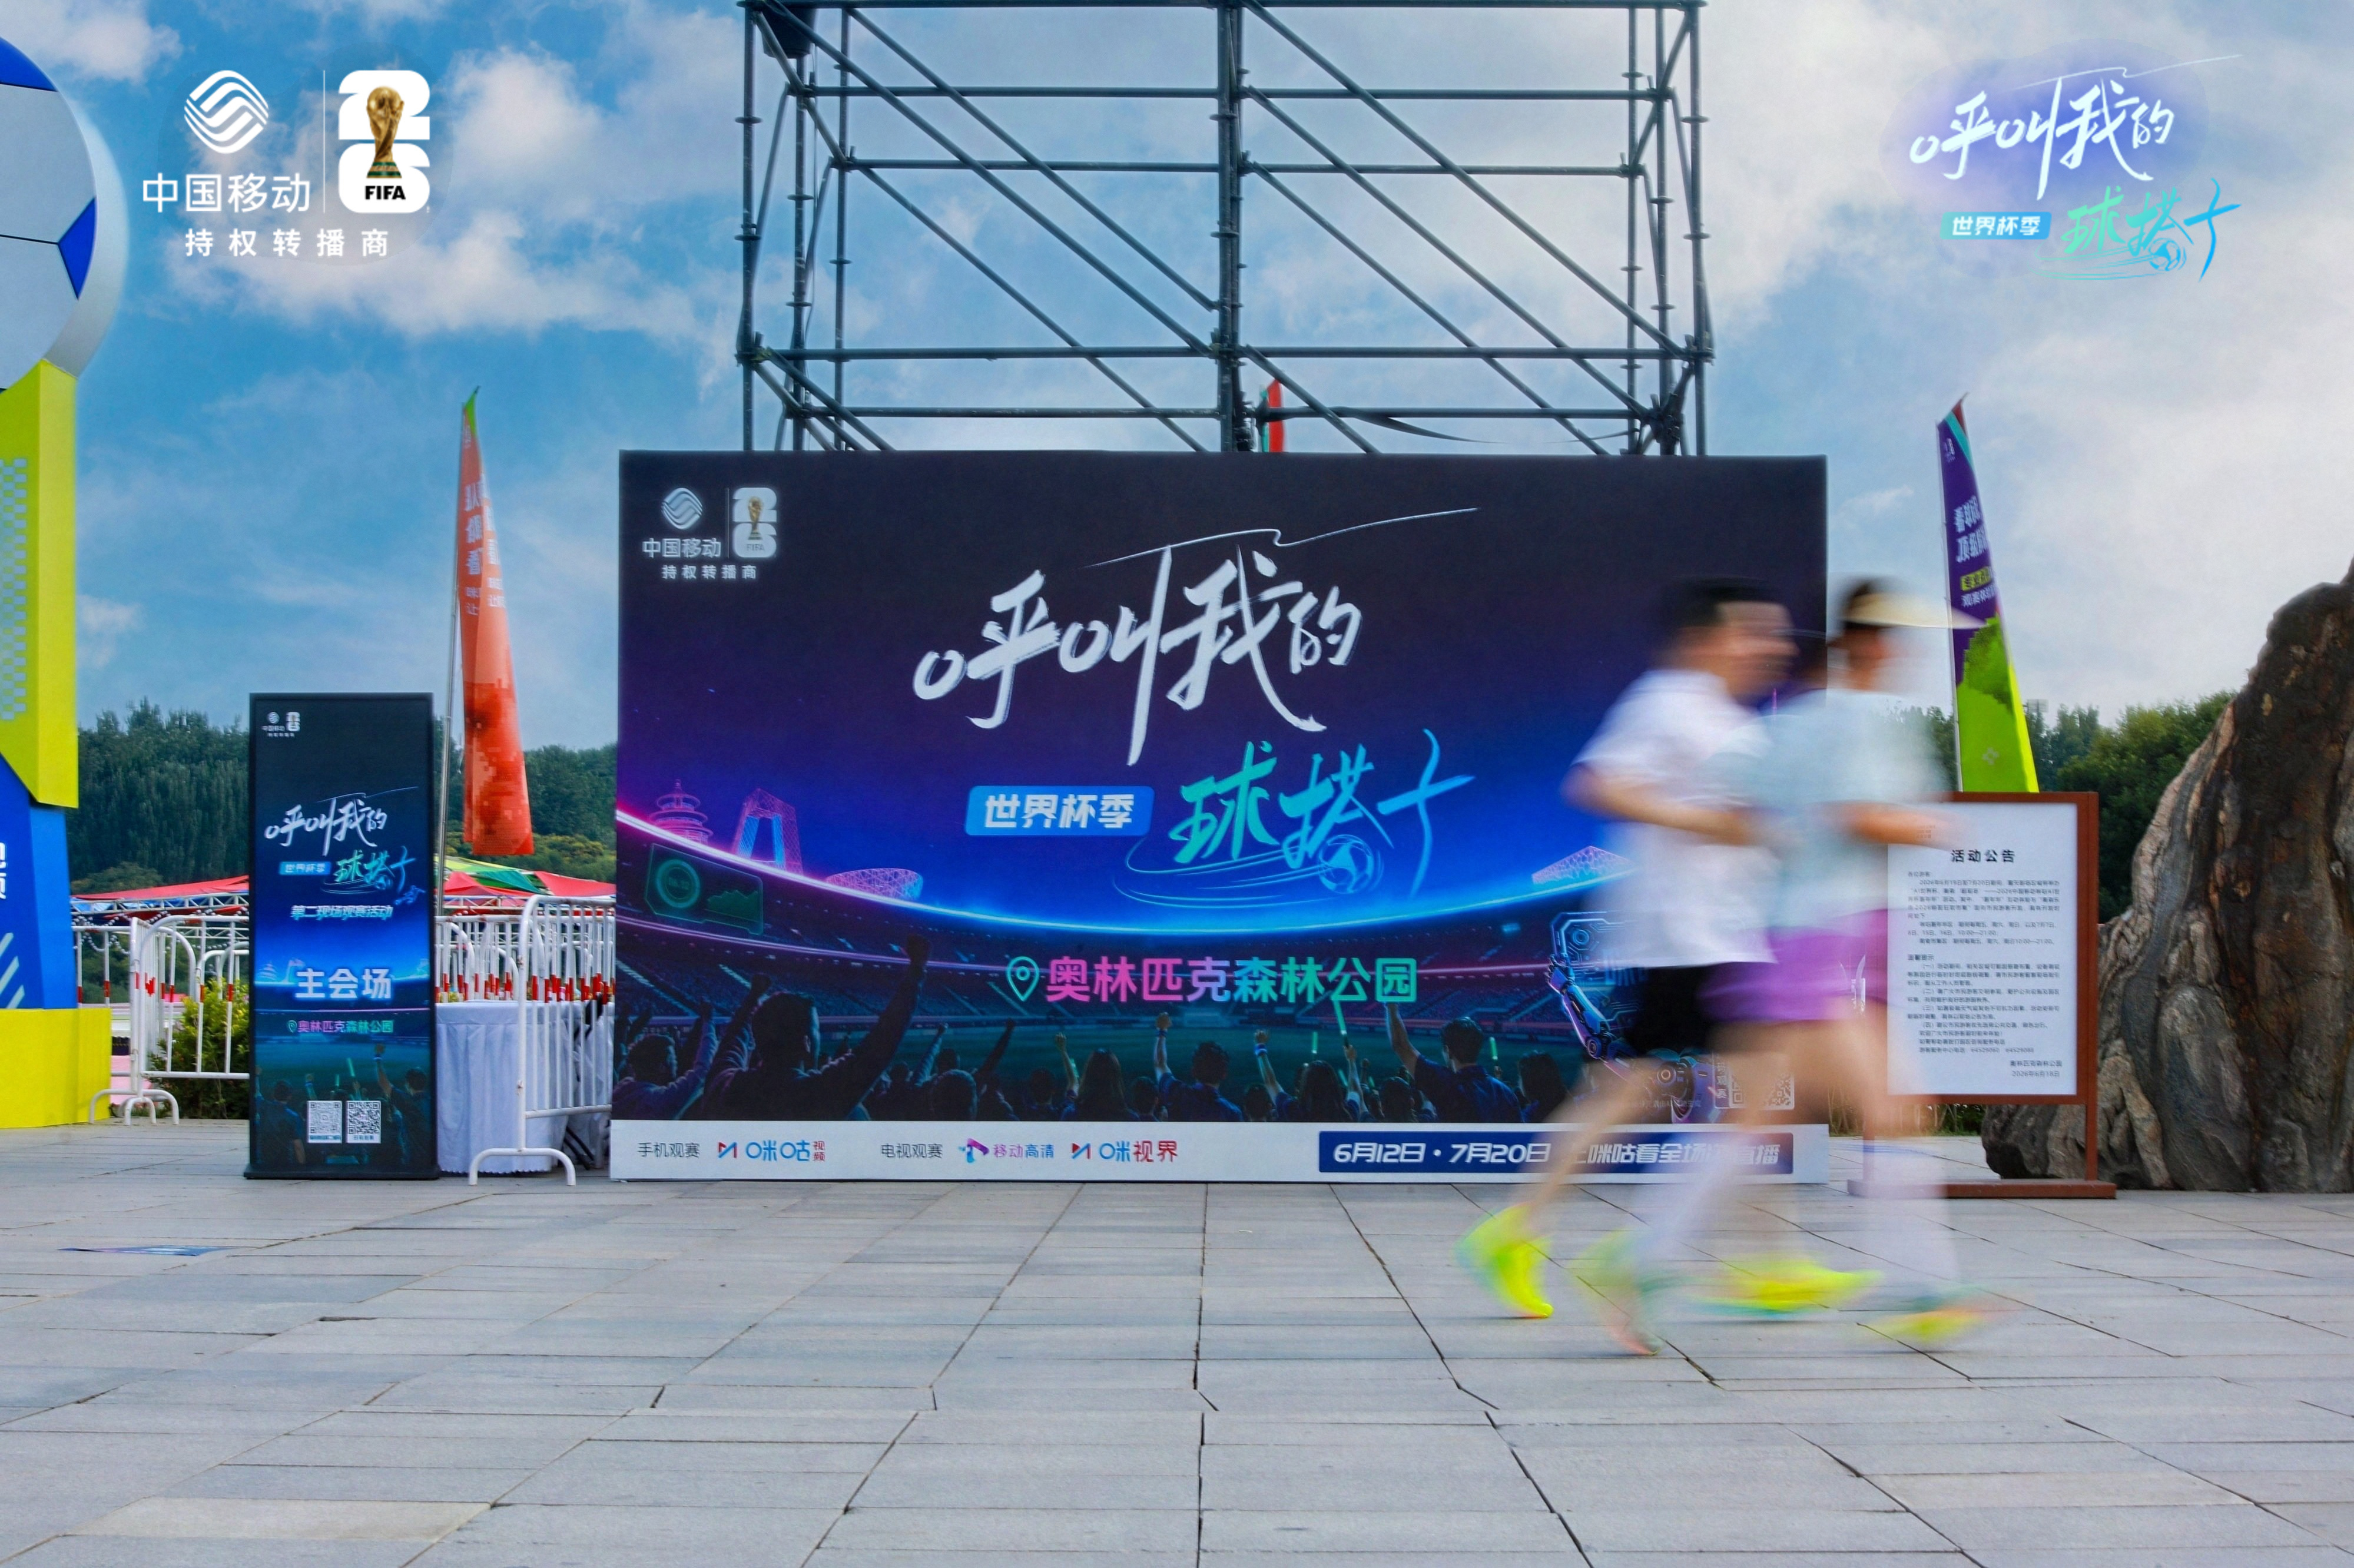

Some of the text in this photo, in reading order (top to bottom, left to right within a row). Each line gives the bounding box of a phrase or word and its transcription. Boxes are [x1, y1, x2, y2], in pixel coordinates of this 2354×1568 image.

[642, 538, 721, 558] 中国移动
[746, 543, 765, 552] FIFA
[661, 565, 757, 579] 持权转播商
[913, 545, 1362, 766] 呼叫我的
[984, 794, 1135, 828] 世界杯季
[264, 798, 388, 857] 呼叫我的
[1951, 849, 2014, 863] 活动公告
[295, 968, 392, 999] 主会场
[1046, 956, 1418, 1002] 奥林匹克森林公园
[297, 1020, 393, 1033] 奥林匹克森林公园
[638, 1142, 700, 1158] 手机观赛
[745, 1140, 811, 1162] 咪咕
[881, 1143, 943, 1159] 电视观赛
[993, 1144, 1055, 1159] 移动高清
[1099, 1140, 1178, 1162] 咪视界
